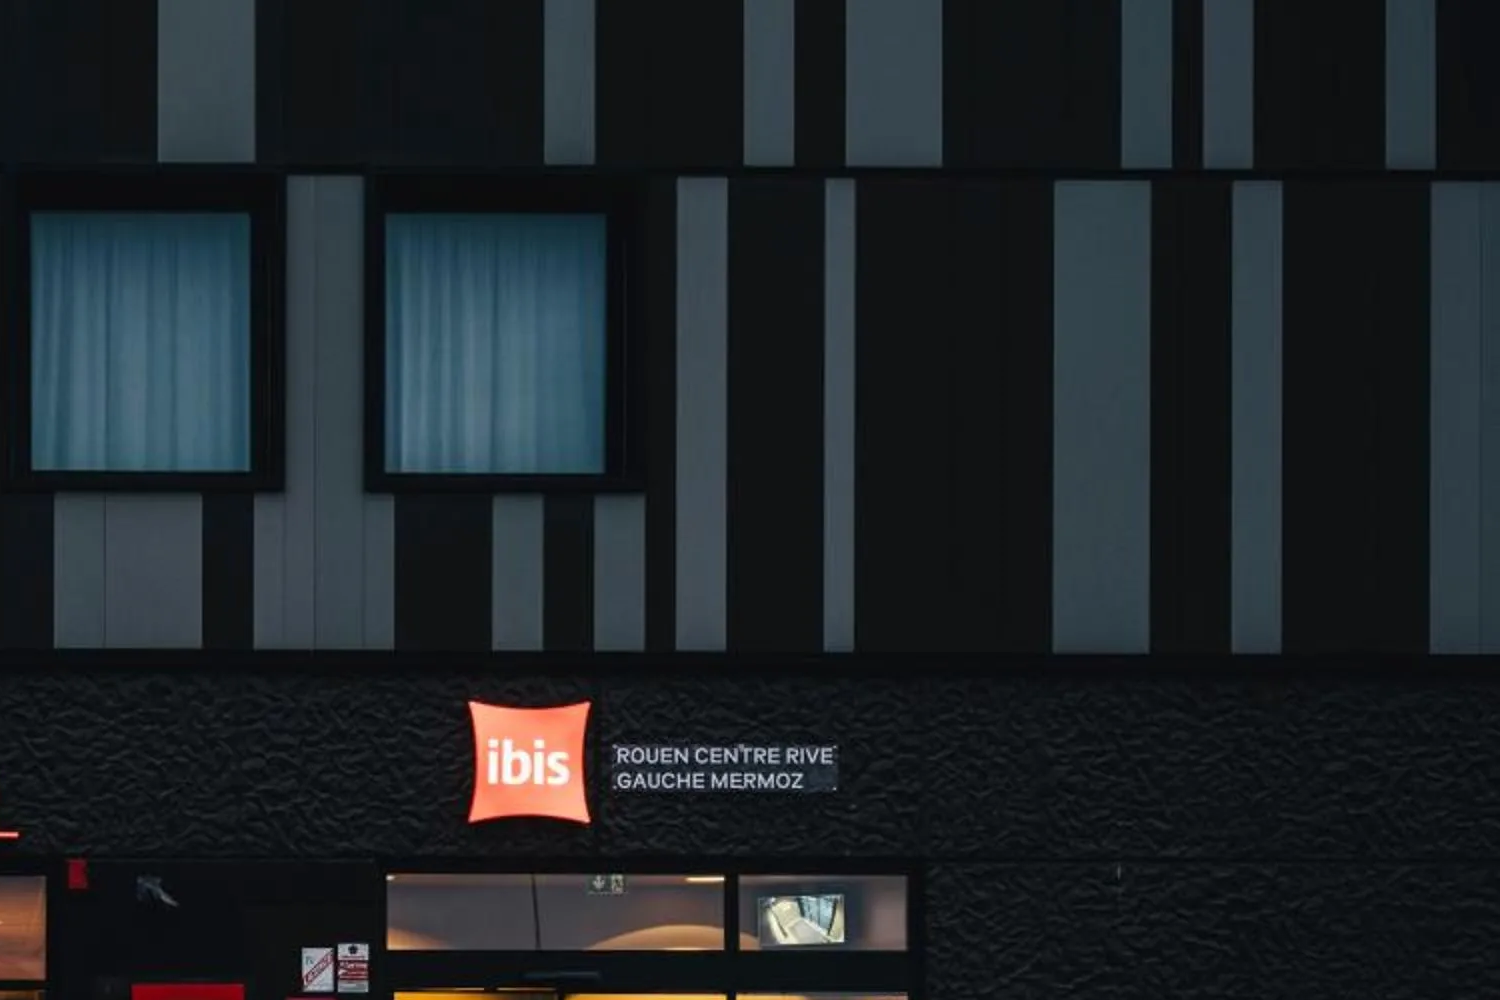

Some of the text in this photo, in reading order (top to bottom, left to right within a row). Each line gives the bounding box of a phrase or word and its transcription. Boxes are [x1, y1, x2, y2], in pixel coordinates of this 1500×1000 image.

[487, 738, 570, 785] ibis
[617, 746, 833, 764] ROUEN CENTRE RIVE
[617, 772, 804, 790] GAUCHE MERMOZ
